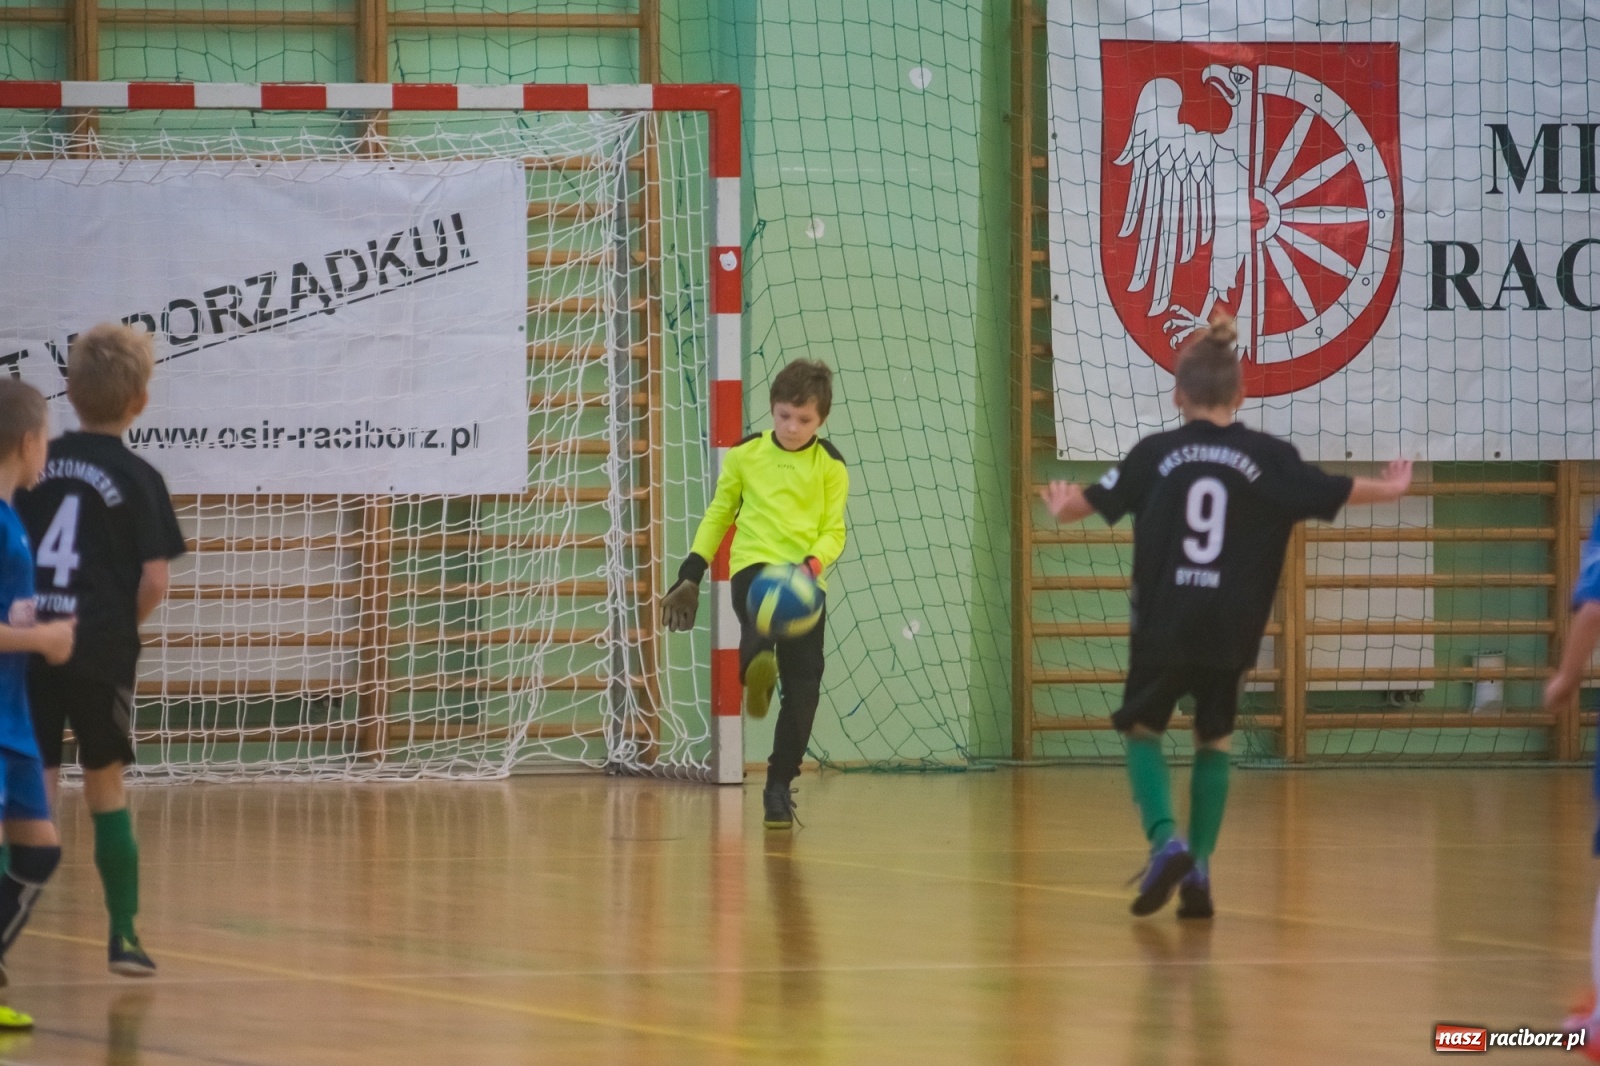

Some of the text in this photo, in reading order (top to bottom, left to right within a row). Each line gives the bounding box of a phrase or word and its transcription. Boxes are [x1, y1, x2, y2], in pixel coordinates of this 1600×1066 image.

[128, 420, 479, 456] www.osir-raciborz.pl
[36, 493, 80, 588] 4
[1182, 476, 1228, 564] 9
